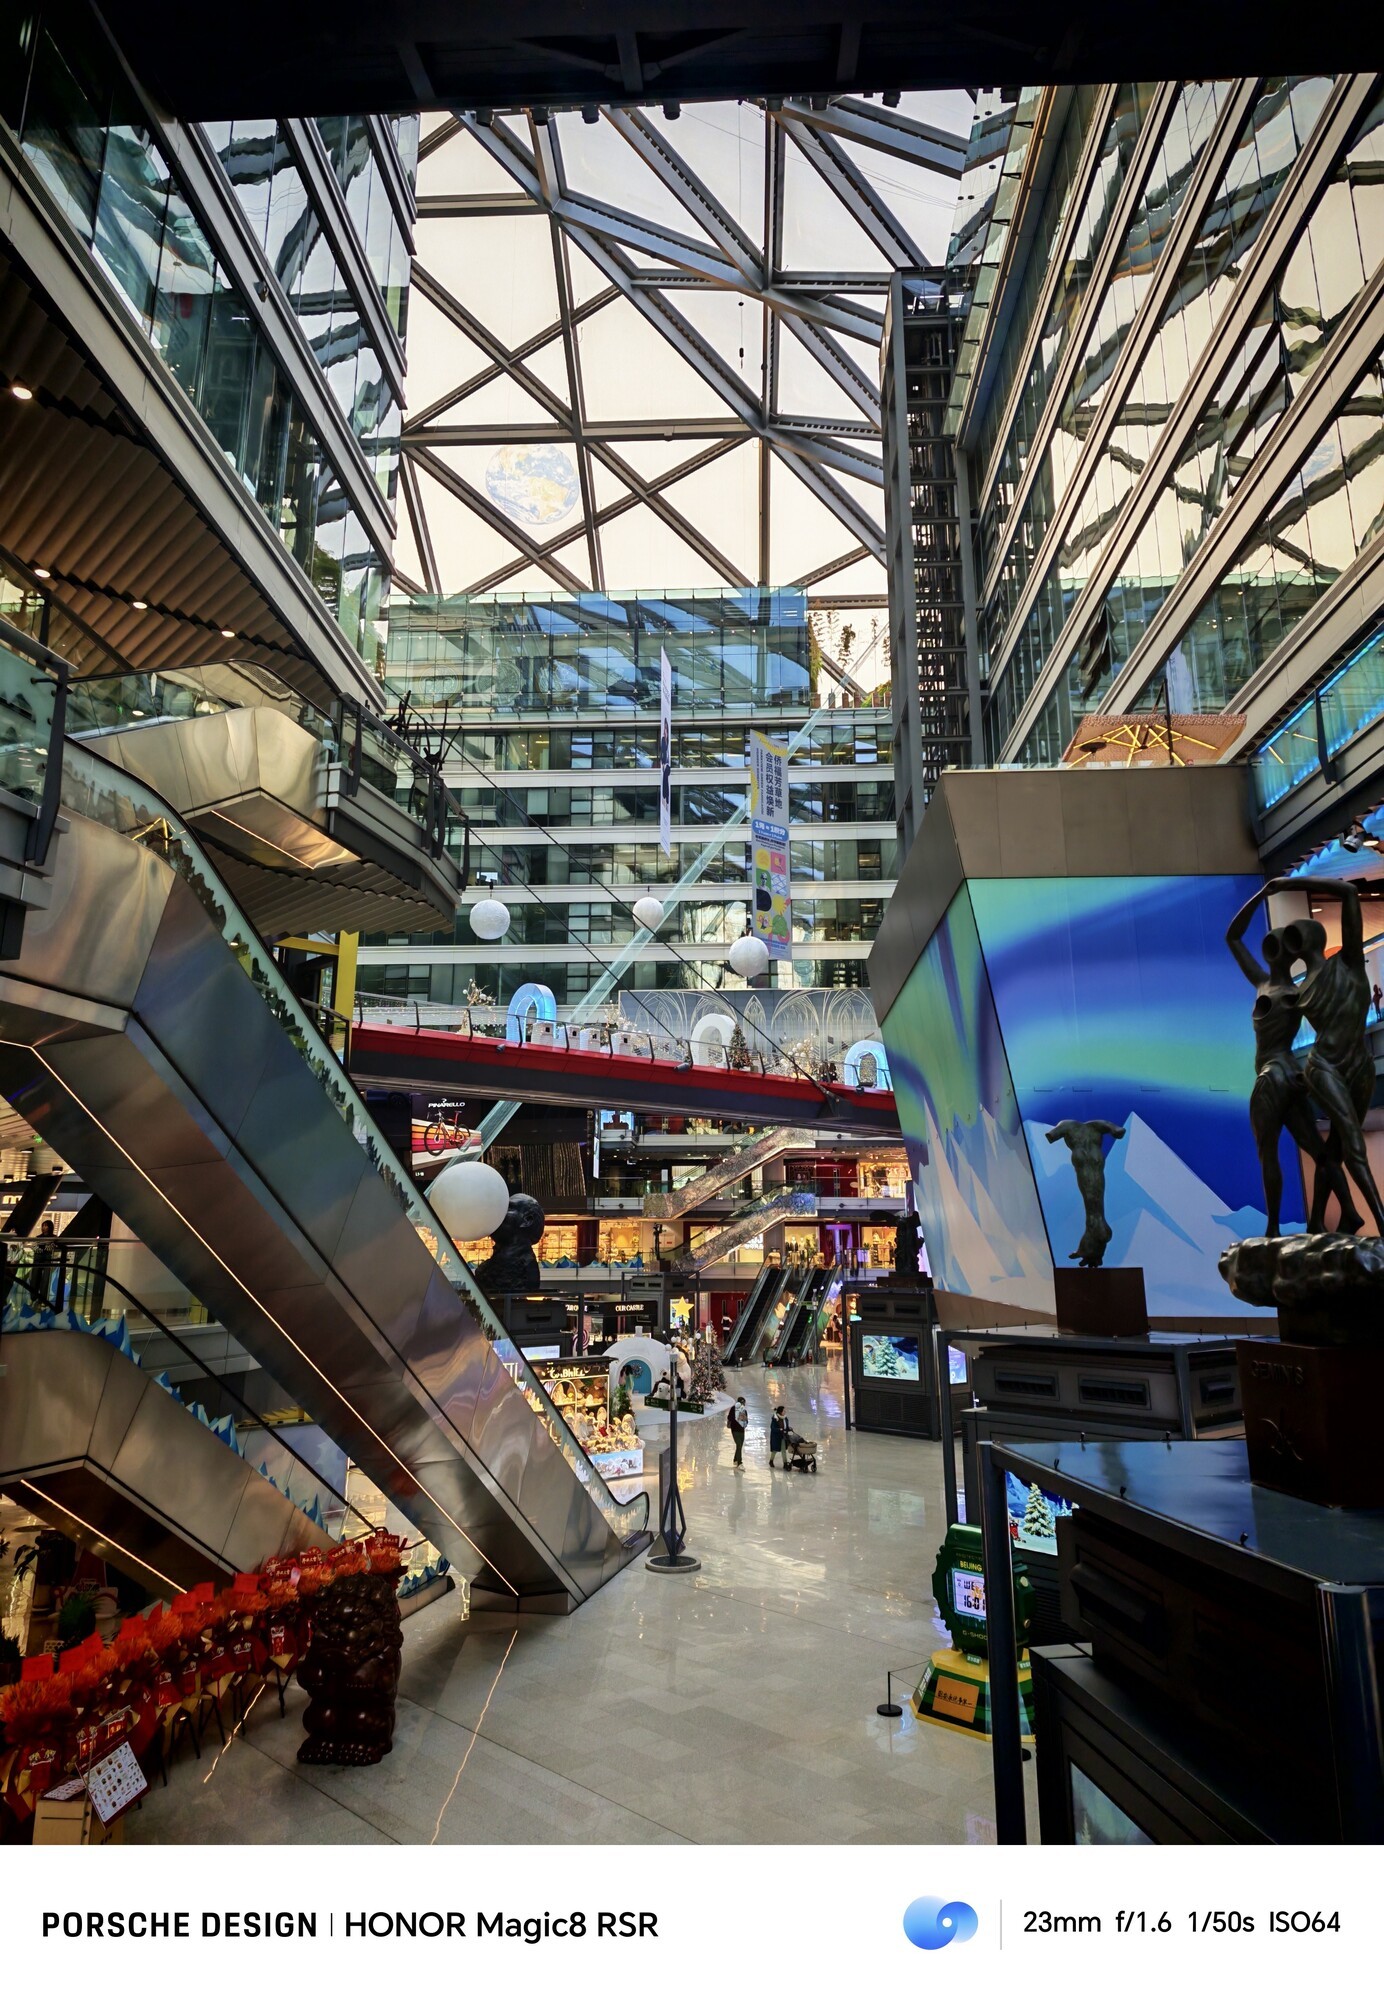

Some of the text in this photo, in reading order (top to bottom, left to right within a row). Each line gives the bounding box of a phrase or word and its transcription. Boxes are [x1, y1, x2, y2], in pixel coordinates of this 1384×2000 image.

[765, 752, 774, 818] 会员权益焕新
[774, 754, 783, 810] 侨福芳草地
[959, 1560, 983, 1572] BEIJING
[962, 1629, 988, 1641] G-SHOC
